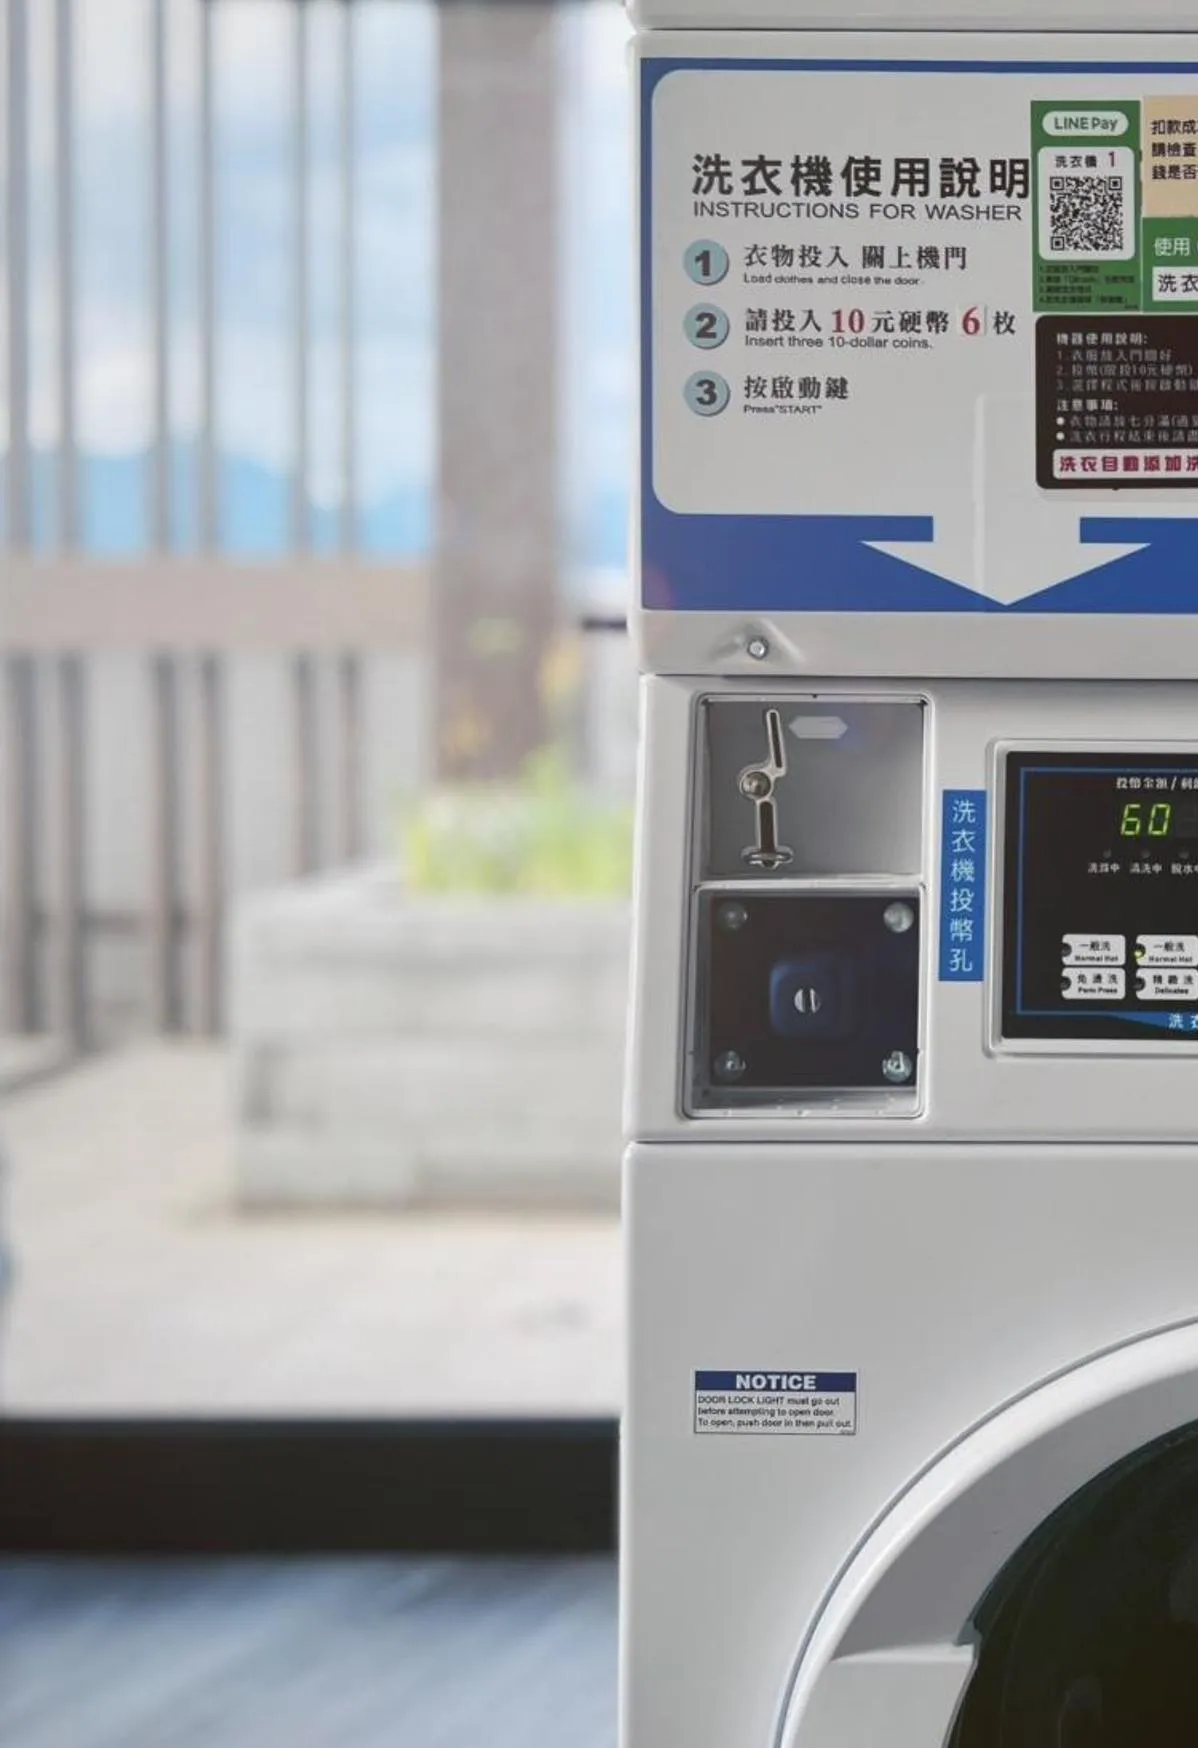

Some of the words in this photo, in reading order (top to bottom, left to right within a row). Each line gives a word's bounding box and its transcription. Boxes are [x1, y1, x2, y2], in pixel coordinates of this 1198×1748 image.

[1053, 116, 1089, 130] LINE
[1092, 117, 1119, 131] Pay
[1055, 155, 1097, 168] 洗衣機
[1107, 151, 1116, 167] 1
[692, 153, 1030, 199] 洗衣機使用說明
[693, 201, 860, 219] INSTRUCTIONS
[869, 202, 917, 220] FOR
[925, 203, 1022, 221] WASHER
[1154, 236, 1191, 256] 使用
[694, 250, 711, 277] 1
[744, 244, 849, 269] 衣物投入
[861, 245, 967, 270] 關上機門
[743, 273, 772, 284] Load
[774, 274, 813, 285] clothes
[817, 275, 838, 285] and
[840, 275, 871, 285] close
[874, 276, 892, 285] the
[694, 312, 717, 339] 2
[962, 306, 981, 336] 6
[993, 310, 1016, 335] 枚
[745, 335, 785, 347] Insert
[788, 336, 823, 348] three
[828, 336, 888, 348] 10-dollar
[695, 379, 718, 406] 3
[743, 375, 849, 400] 按啟動鍵
[1120, 802, 1172, 836] 60
[950, 799, 976, 973] 洗衣機投幣孔
[735, 1374, 817, 1390] NOTICE
[697, 1396, 726, 1405] DOOR
[728, 1396, 753, 1405] LOCK
[756, 1396, 785, 1405] LIGHT
[787, 1397, 809, 1405] must
[811, 1398, 823, 1407] go
[825, 1398, 840, 1406] out
[697, 1407, 726, 1415] before
[728, 1407, 776, 1417] attempting
[777, 1408, 787, 1416] to
[788, 1409, 811, 1418] open
[697, 1419, 709, 1427] To
[737, 1419, 760, 1428] push
[762, 1419, 782, 1427] door
[784, 1419, 793, 1427] in
[795, 1419, 815, 1428] then
[817, 1420, 835, 1429] pull
